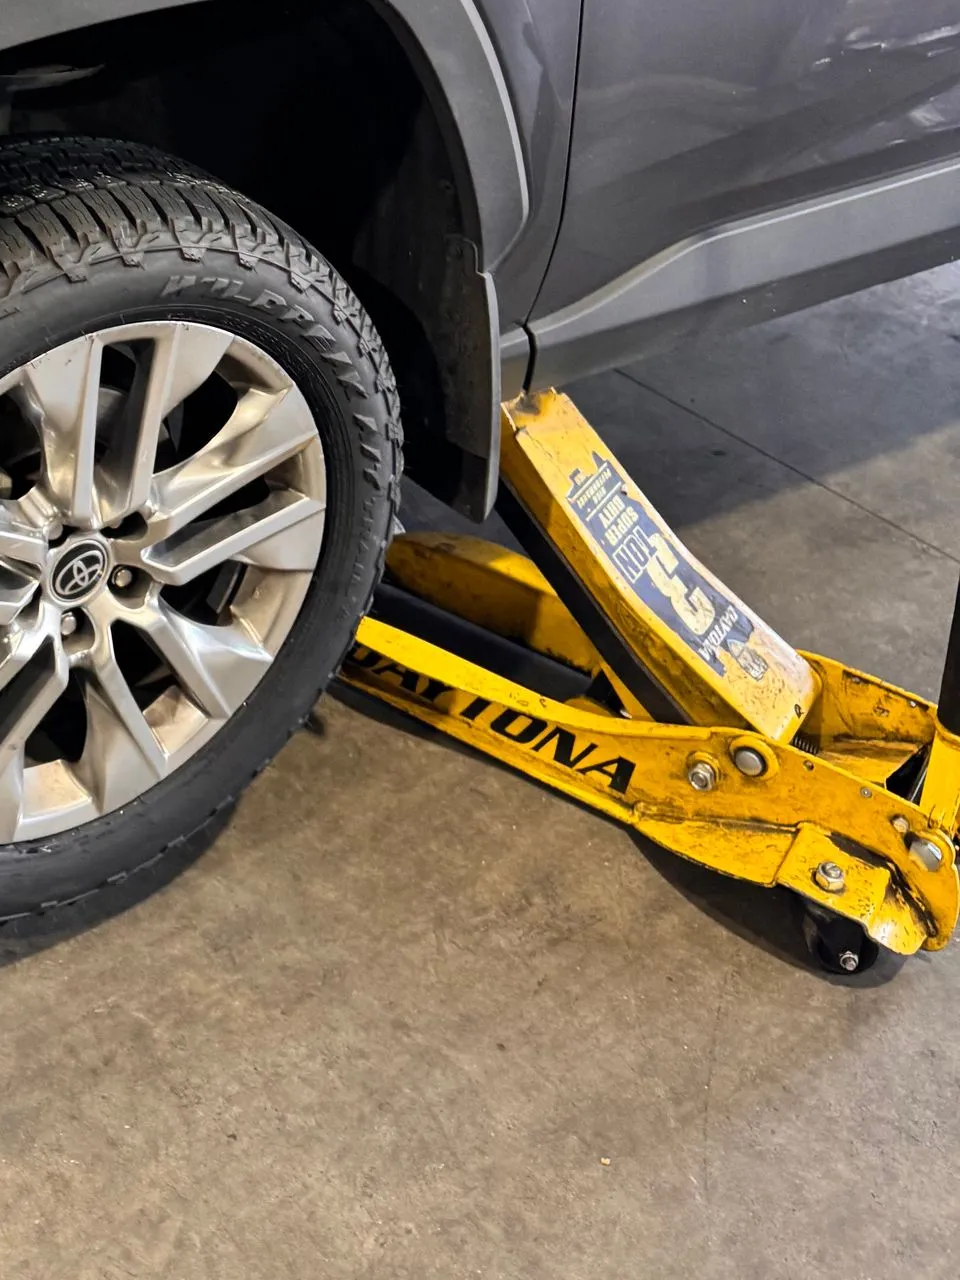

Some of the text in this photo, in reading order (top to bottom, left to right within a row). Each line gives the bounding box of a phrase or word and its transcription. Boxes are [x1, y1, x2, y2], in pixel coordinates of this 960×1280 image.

[598, 494, 626, 529] DUTY
[604, 506, 640, 547] SUPER
[612, 524, 657, 585] TON
[646, 532, 717, 636] 3
